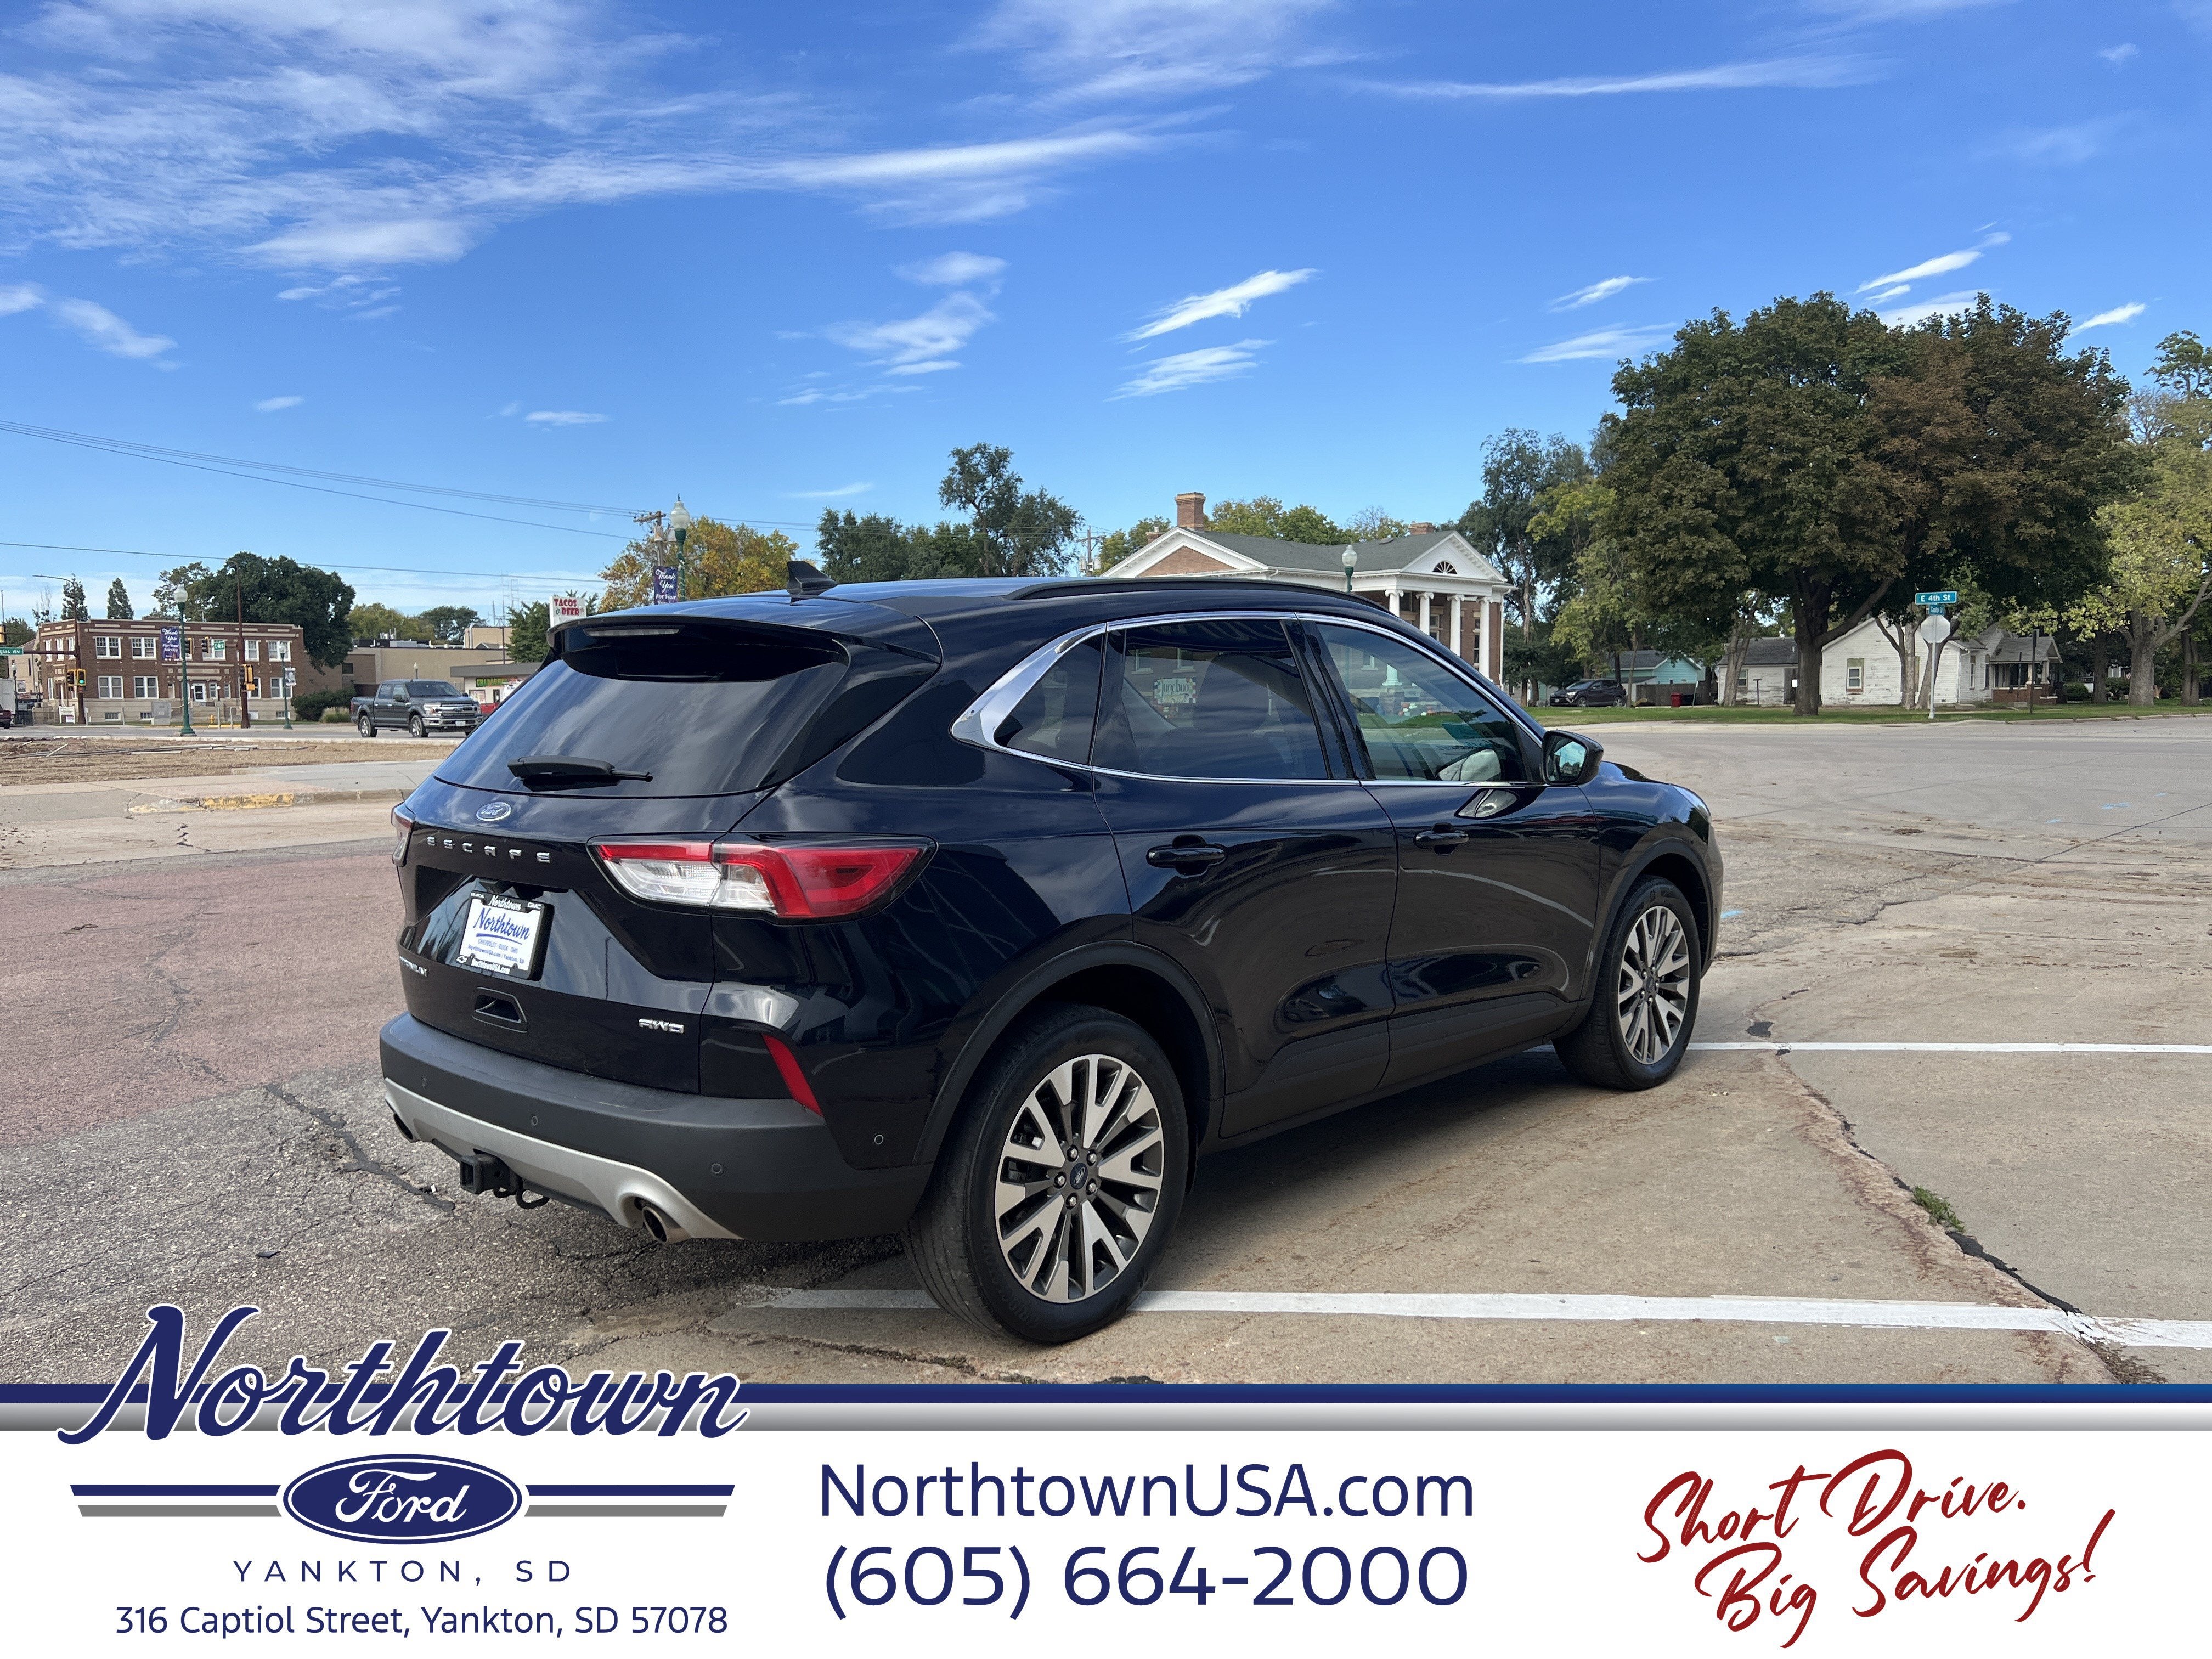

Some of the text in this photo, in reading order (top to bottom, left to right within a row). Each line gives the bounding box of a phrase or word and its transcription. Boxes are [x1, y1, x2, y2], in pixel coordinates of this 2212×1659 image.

[655, 569, 676, 580] Thank
[659, 580, 674, 593] You
[554, 598, 577, 607] TACOS
[561, 607, 580, 616] BEER
[427, 836, 550, 864] ESCAPE
[488, 895, 522, 911] Northtown
[473, 907, 531, 940] Northtown
[638, 1018, 684, 1034] AWD
